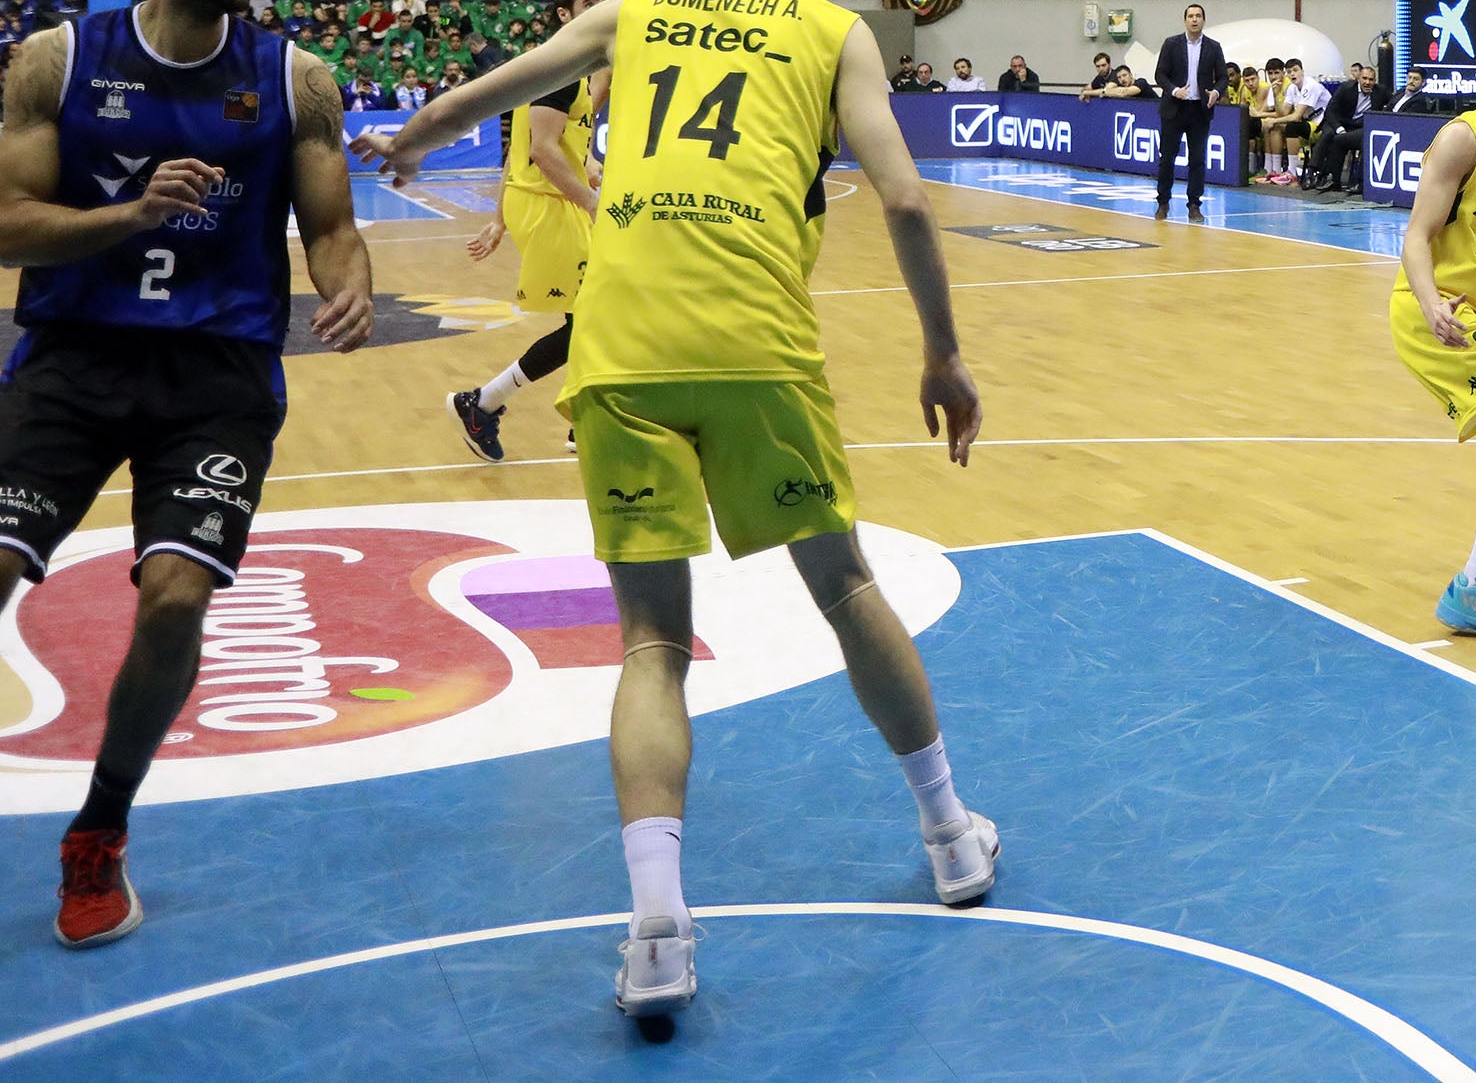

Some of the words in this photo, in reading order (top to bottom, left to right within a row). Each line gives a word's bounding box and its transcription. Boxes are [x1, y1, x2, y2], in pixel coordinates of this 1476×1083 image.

[781, 0, 803, 21] A.
[91, 78, 146, 92] GIVOVA
[642, 64, 748, 161] 14
[996, 115, 1072, 154] GIVOVA
[651, 192, 699, 209] CAJA
[702, 194, 766, 224] RURAL
[652, 211, 670, 223] DE
[672, 212, 734, 225] ASTURIAS
[138, 248, 176, 301] 2
[172, 487, 253, 515] LEXUS
